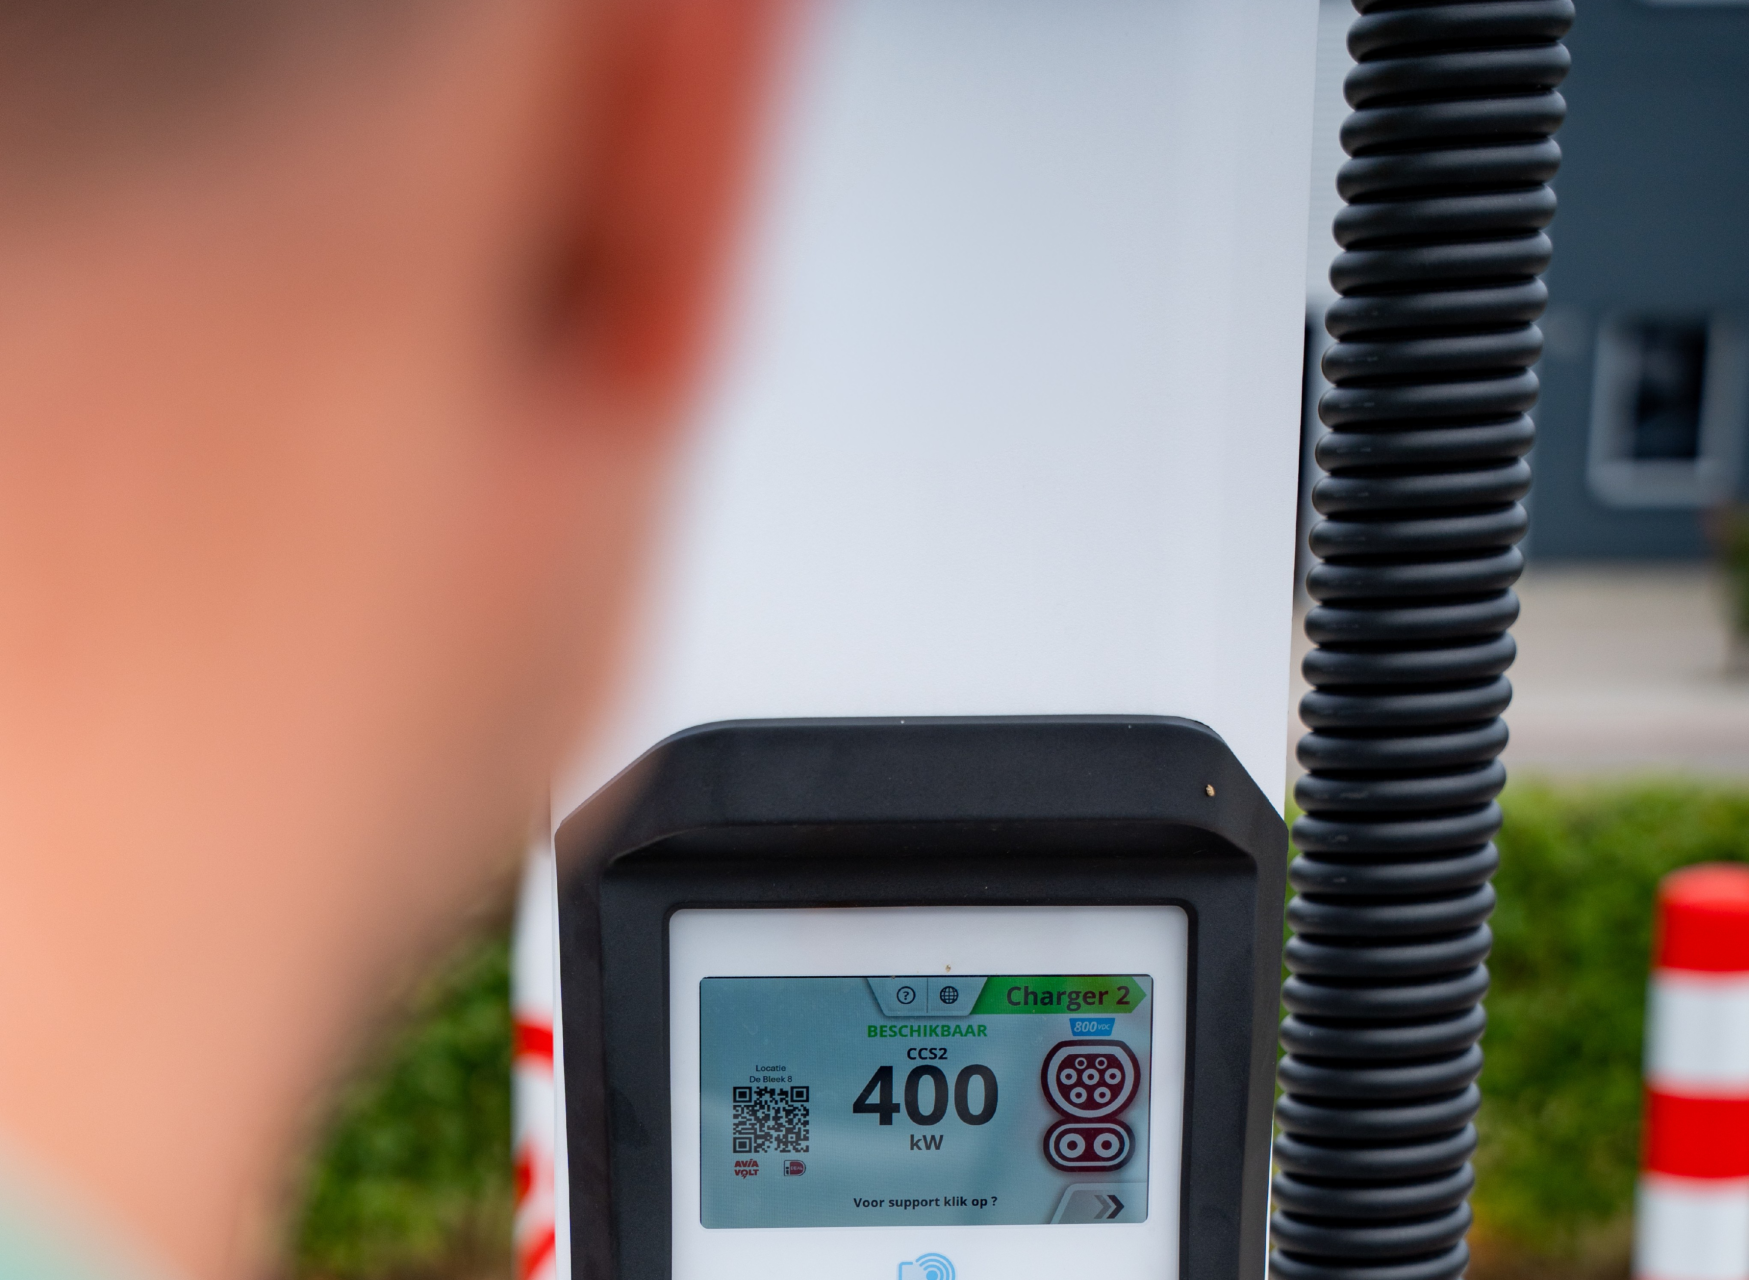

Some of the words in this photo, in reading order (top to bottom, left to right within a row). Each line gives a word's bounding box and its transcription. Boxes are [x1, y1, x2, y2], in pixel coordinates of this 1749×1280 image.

[1006, 986, 1108, 1012] Charger
[1116, 986, 1130, 1005] 2
[867, 1024, 987, 1037] BESCHIKBAAR
[907, 1048, 948, 1060] CCS2
[853, 1064, 998, 1126] 400
[910, 1134, 944, 1151] kW
[734, 1169, 759, 1179] VOLT
[853, 1197, 885, 1208] Voor
[888, 1197, 941, 1210] support
[943, 1196, 968, 1207] klik
[971, 1198, 988, 1209] op
[991, 1196, 998, 1206] ?
